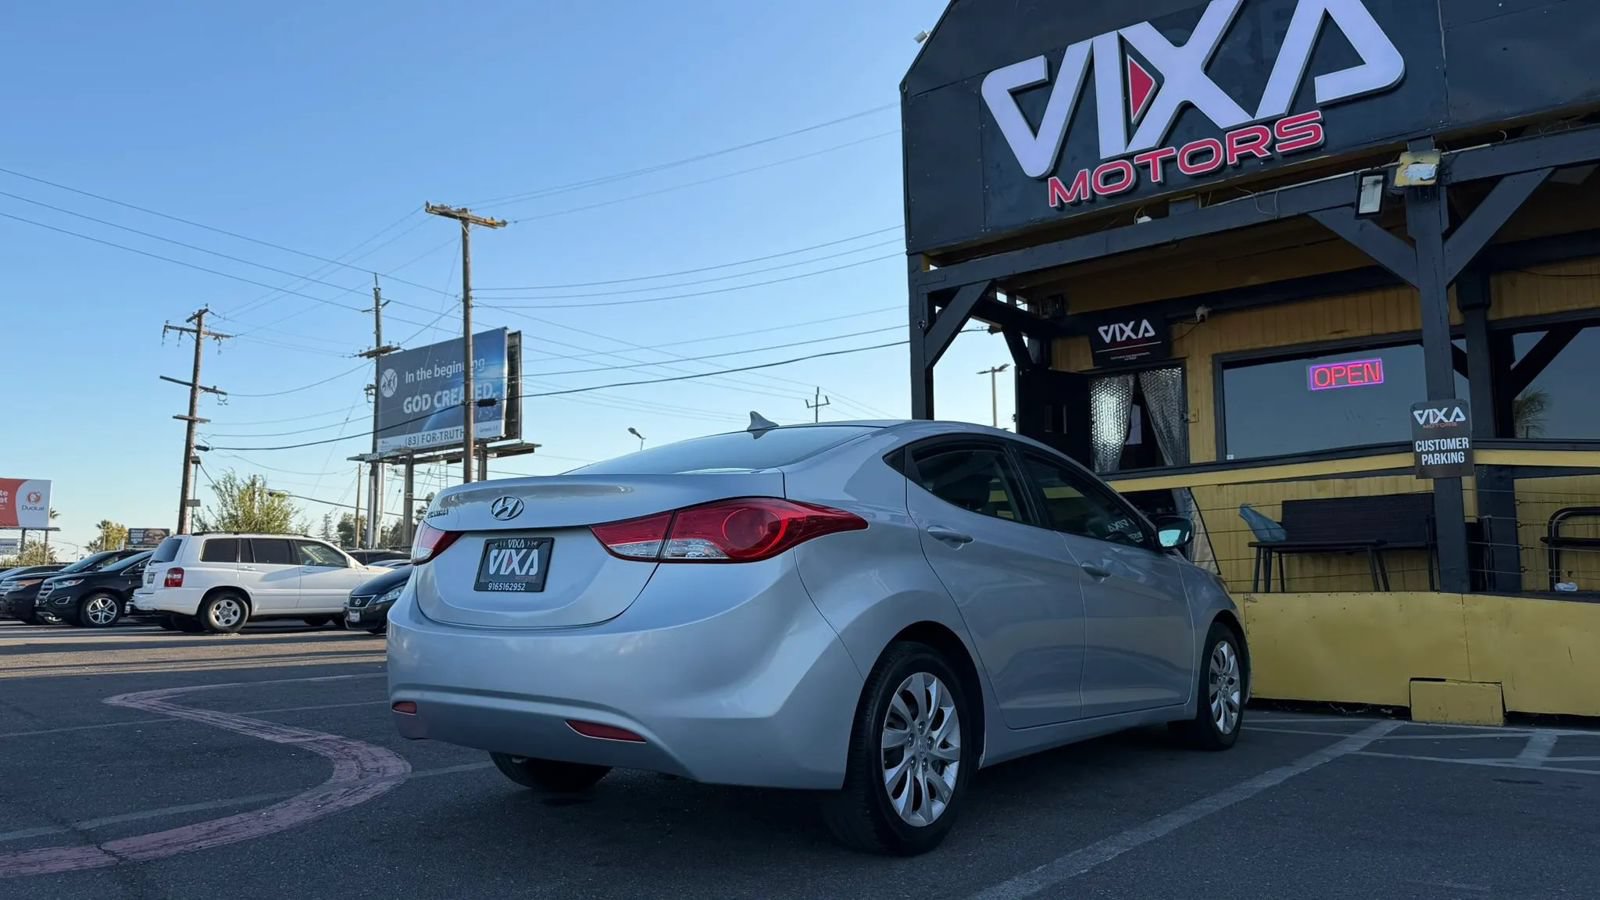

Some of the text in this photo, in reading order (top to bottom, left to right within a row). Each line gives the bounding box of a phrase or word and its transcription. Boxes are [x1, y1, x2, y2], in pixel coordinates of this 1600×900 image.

[981, 0, 1406, 178] VIXA
[1048, 109, 1326, 208] MOTORS
[1097, 318, 1156, 344] VIXA
[405, 371, 415, 384] In
[416, 366, 433, 381] the
[1314, 361, 1380, 387] OPEN
[403, 393, 431, 414] GOD
[1413, 406, 1466, 425] VIXA
[405, 436, 420, 446] (83)
[1415, 437, 1469, 452] CUSTOMER
[1421, 451, 1465, 466] PARKING
[508, 539, 524, 548] VIXA
[489, 548, 539, 576] VIXA
